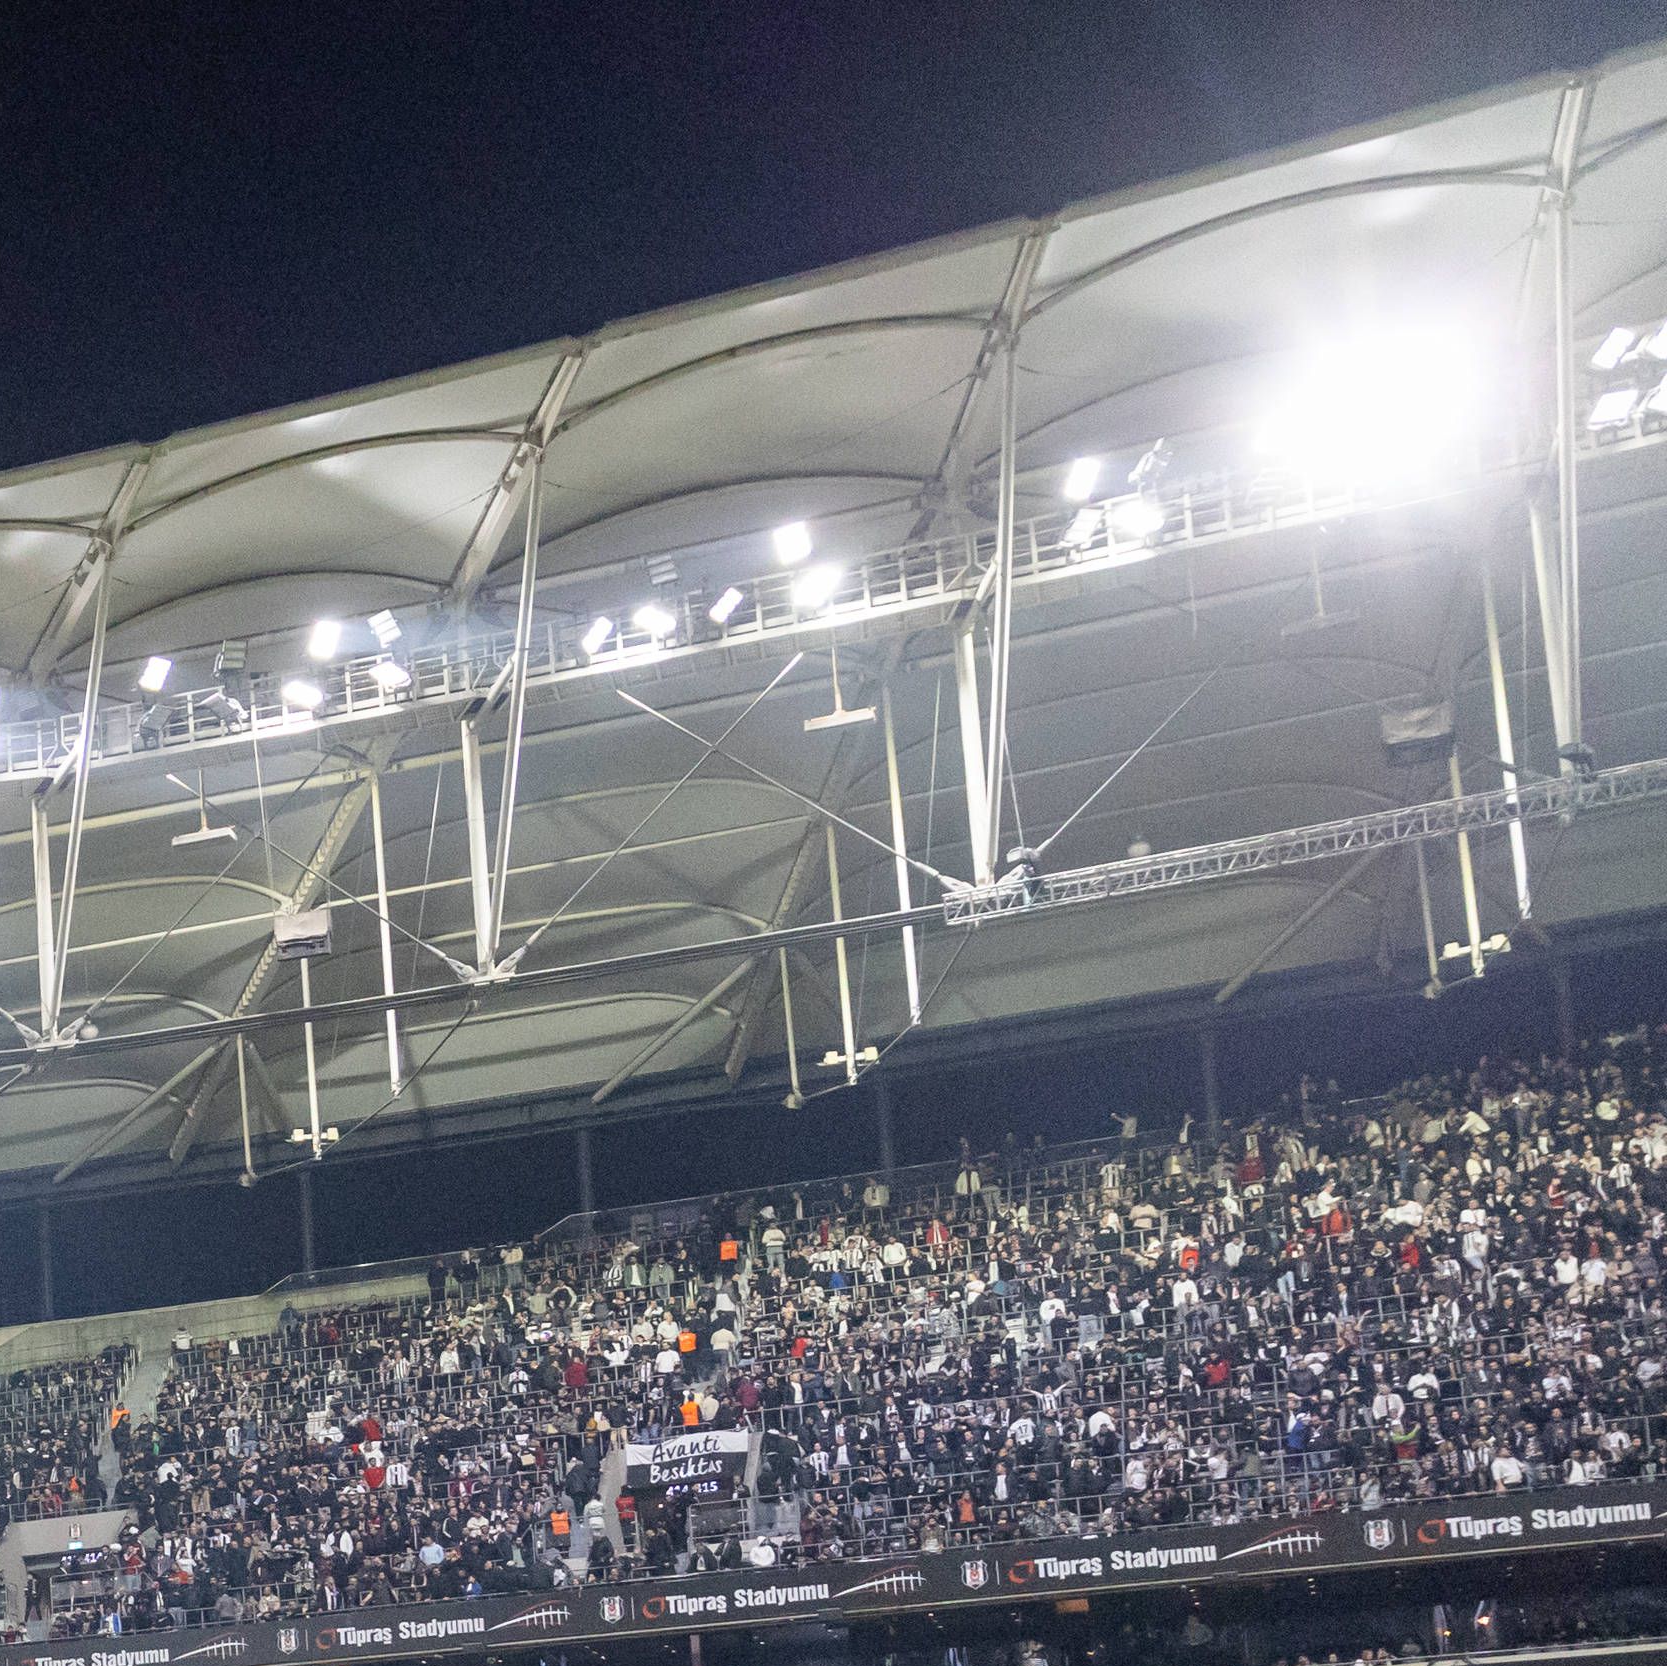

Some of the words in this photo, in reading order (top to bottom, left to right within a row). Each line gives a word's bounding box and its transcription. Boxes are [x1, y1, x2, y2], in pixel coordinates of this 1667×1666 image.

[652, 1435, 722, 1462] Avanti
[1443, 1515, 1524, 1541] Tüpraş
[1530, 1502, 1653, 1530] Stadyumu
[1033, 1556, 1103, 1580] Tüpraş
[1110, 1544, 1218, 1571] Stadyumu
[665, 1594, 728, 1616] Tüpraş
[733, 1583, 830, 1608] Stadyumu
[336, 1626, 393, 1648] Tüpraş
[398, 1617, 486, 1641] Stadyumu
